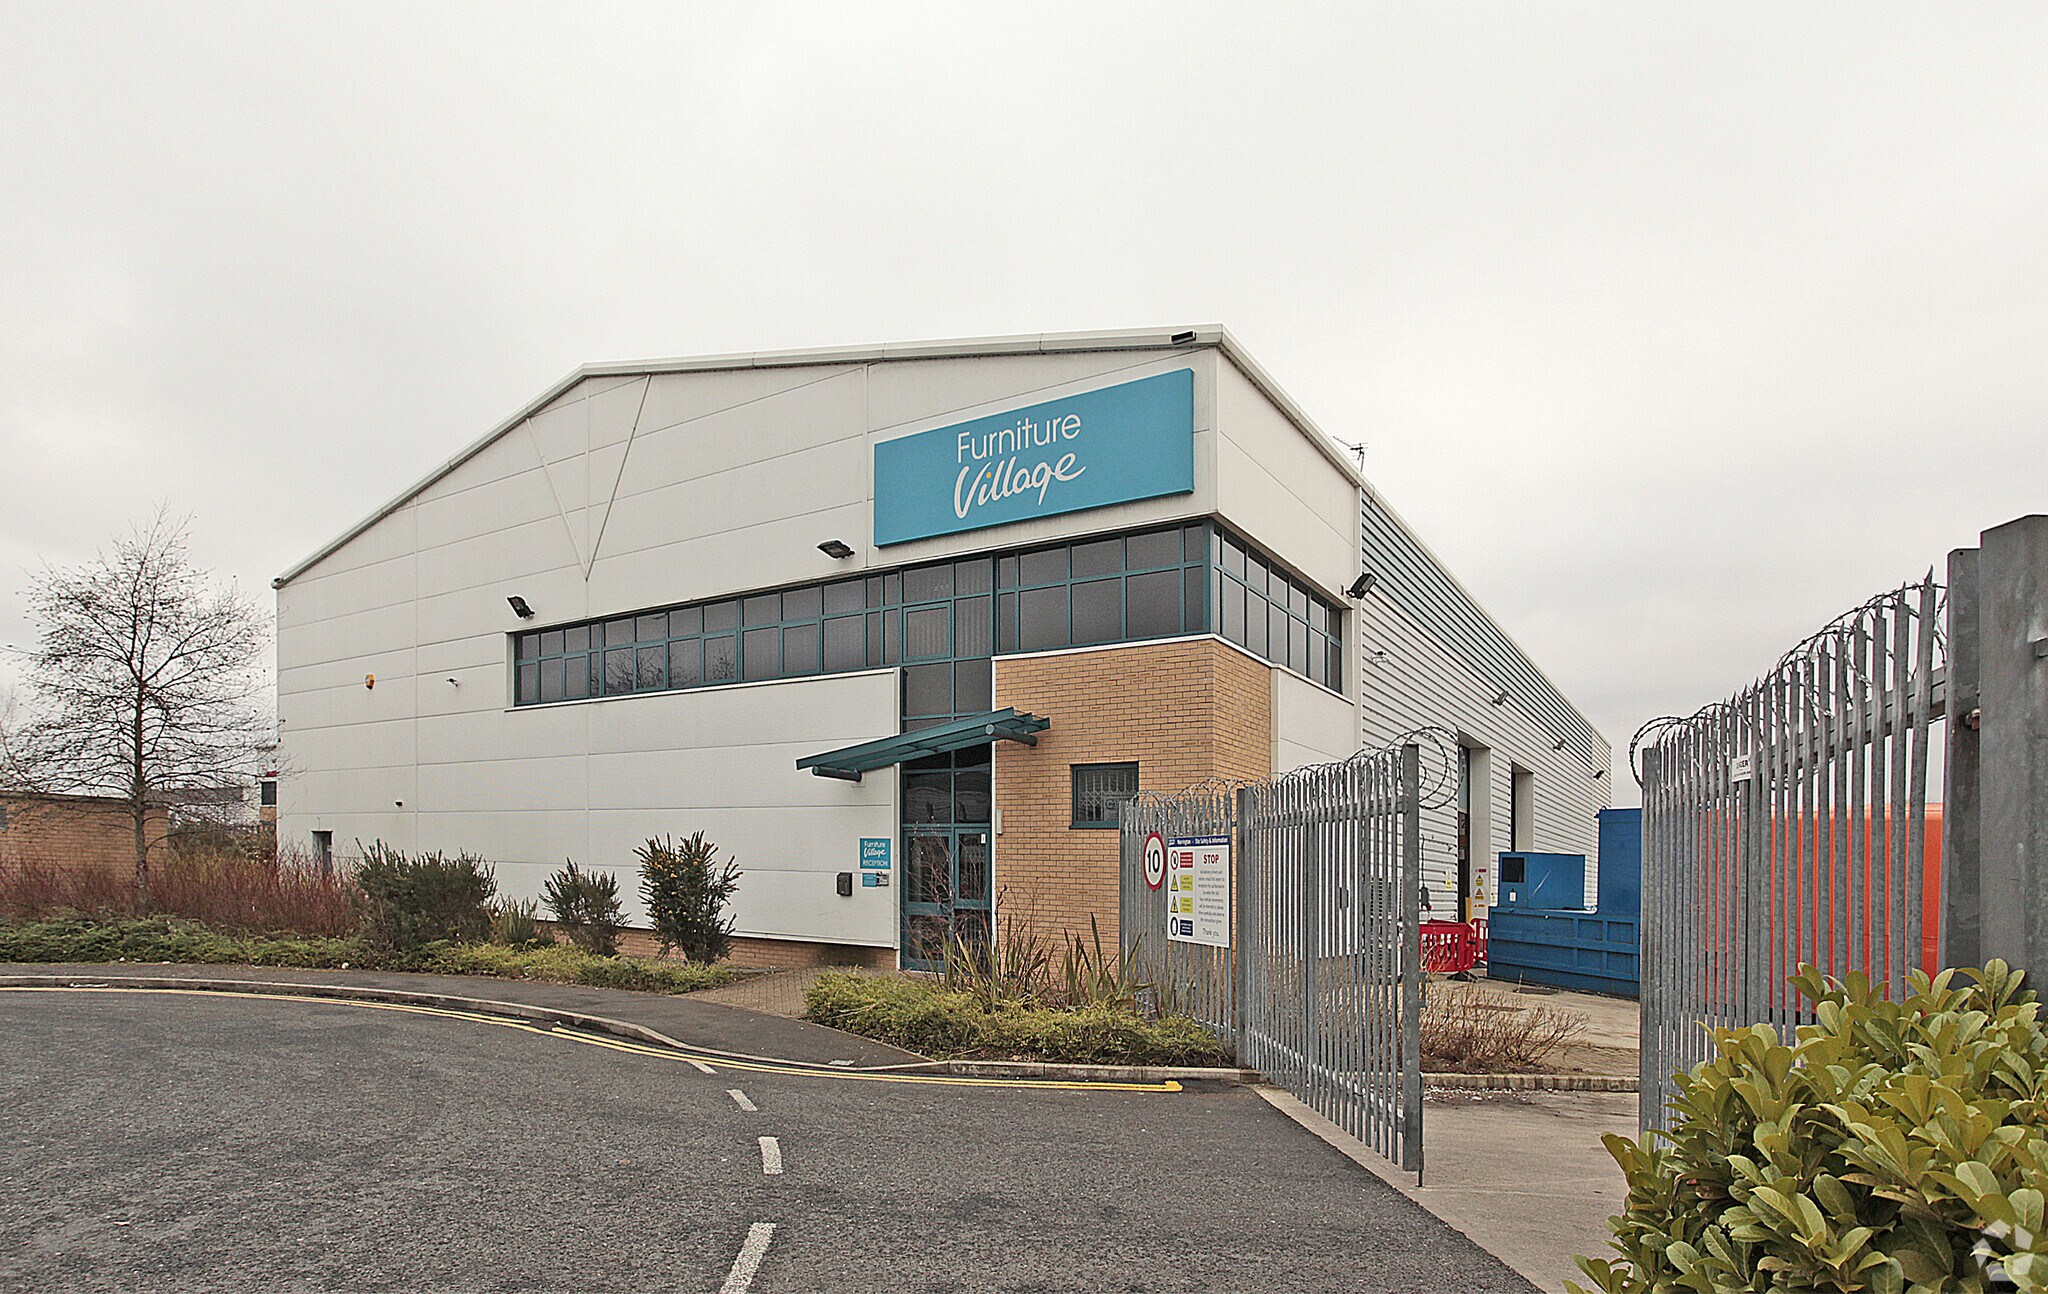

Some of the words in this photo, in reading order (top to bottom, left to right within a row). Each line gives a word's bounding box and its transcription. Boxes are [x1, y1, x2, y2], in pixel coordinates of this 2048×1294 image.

[957, 413, 1082, 464] Furniture
[954, 452, 1087, 519] Village
[864, 840, 886, 848] Furniture
[863, 847, 887, 858] Village
[862, 859, 888, 867] RECEPTION
[1147, 849, 1161, 874] 10
[1203, 854, 1220, 864] STOP
